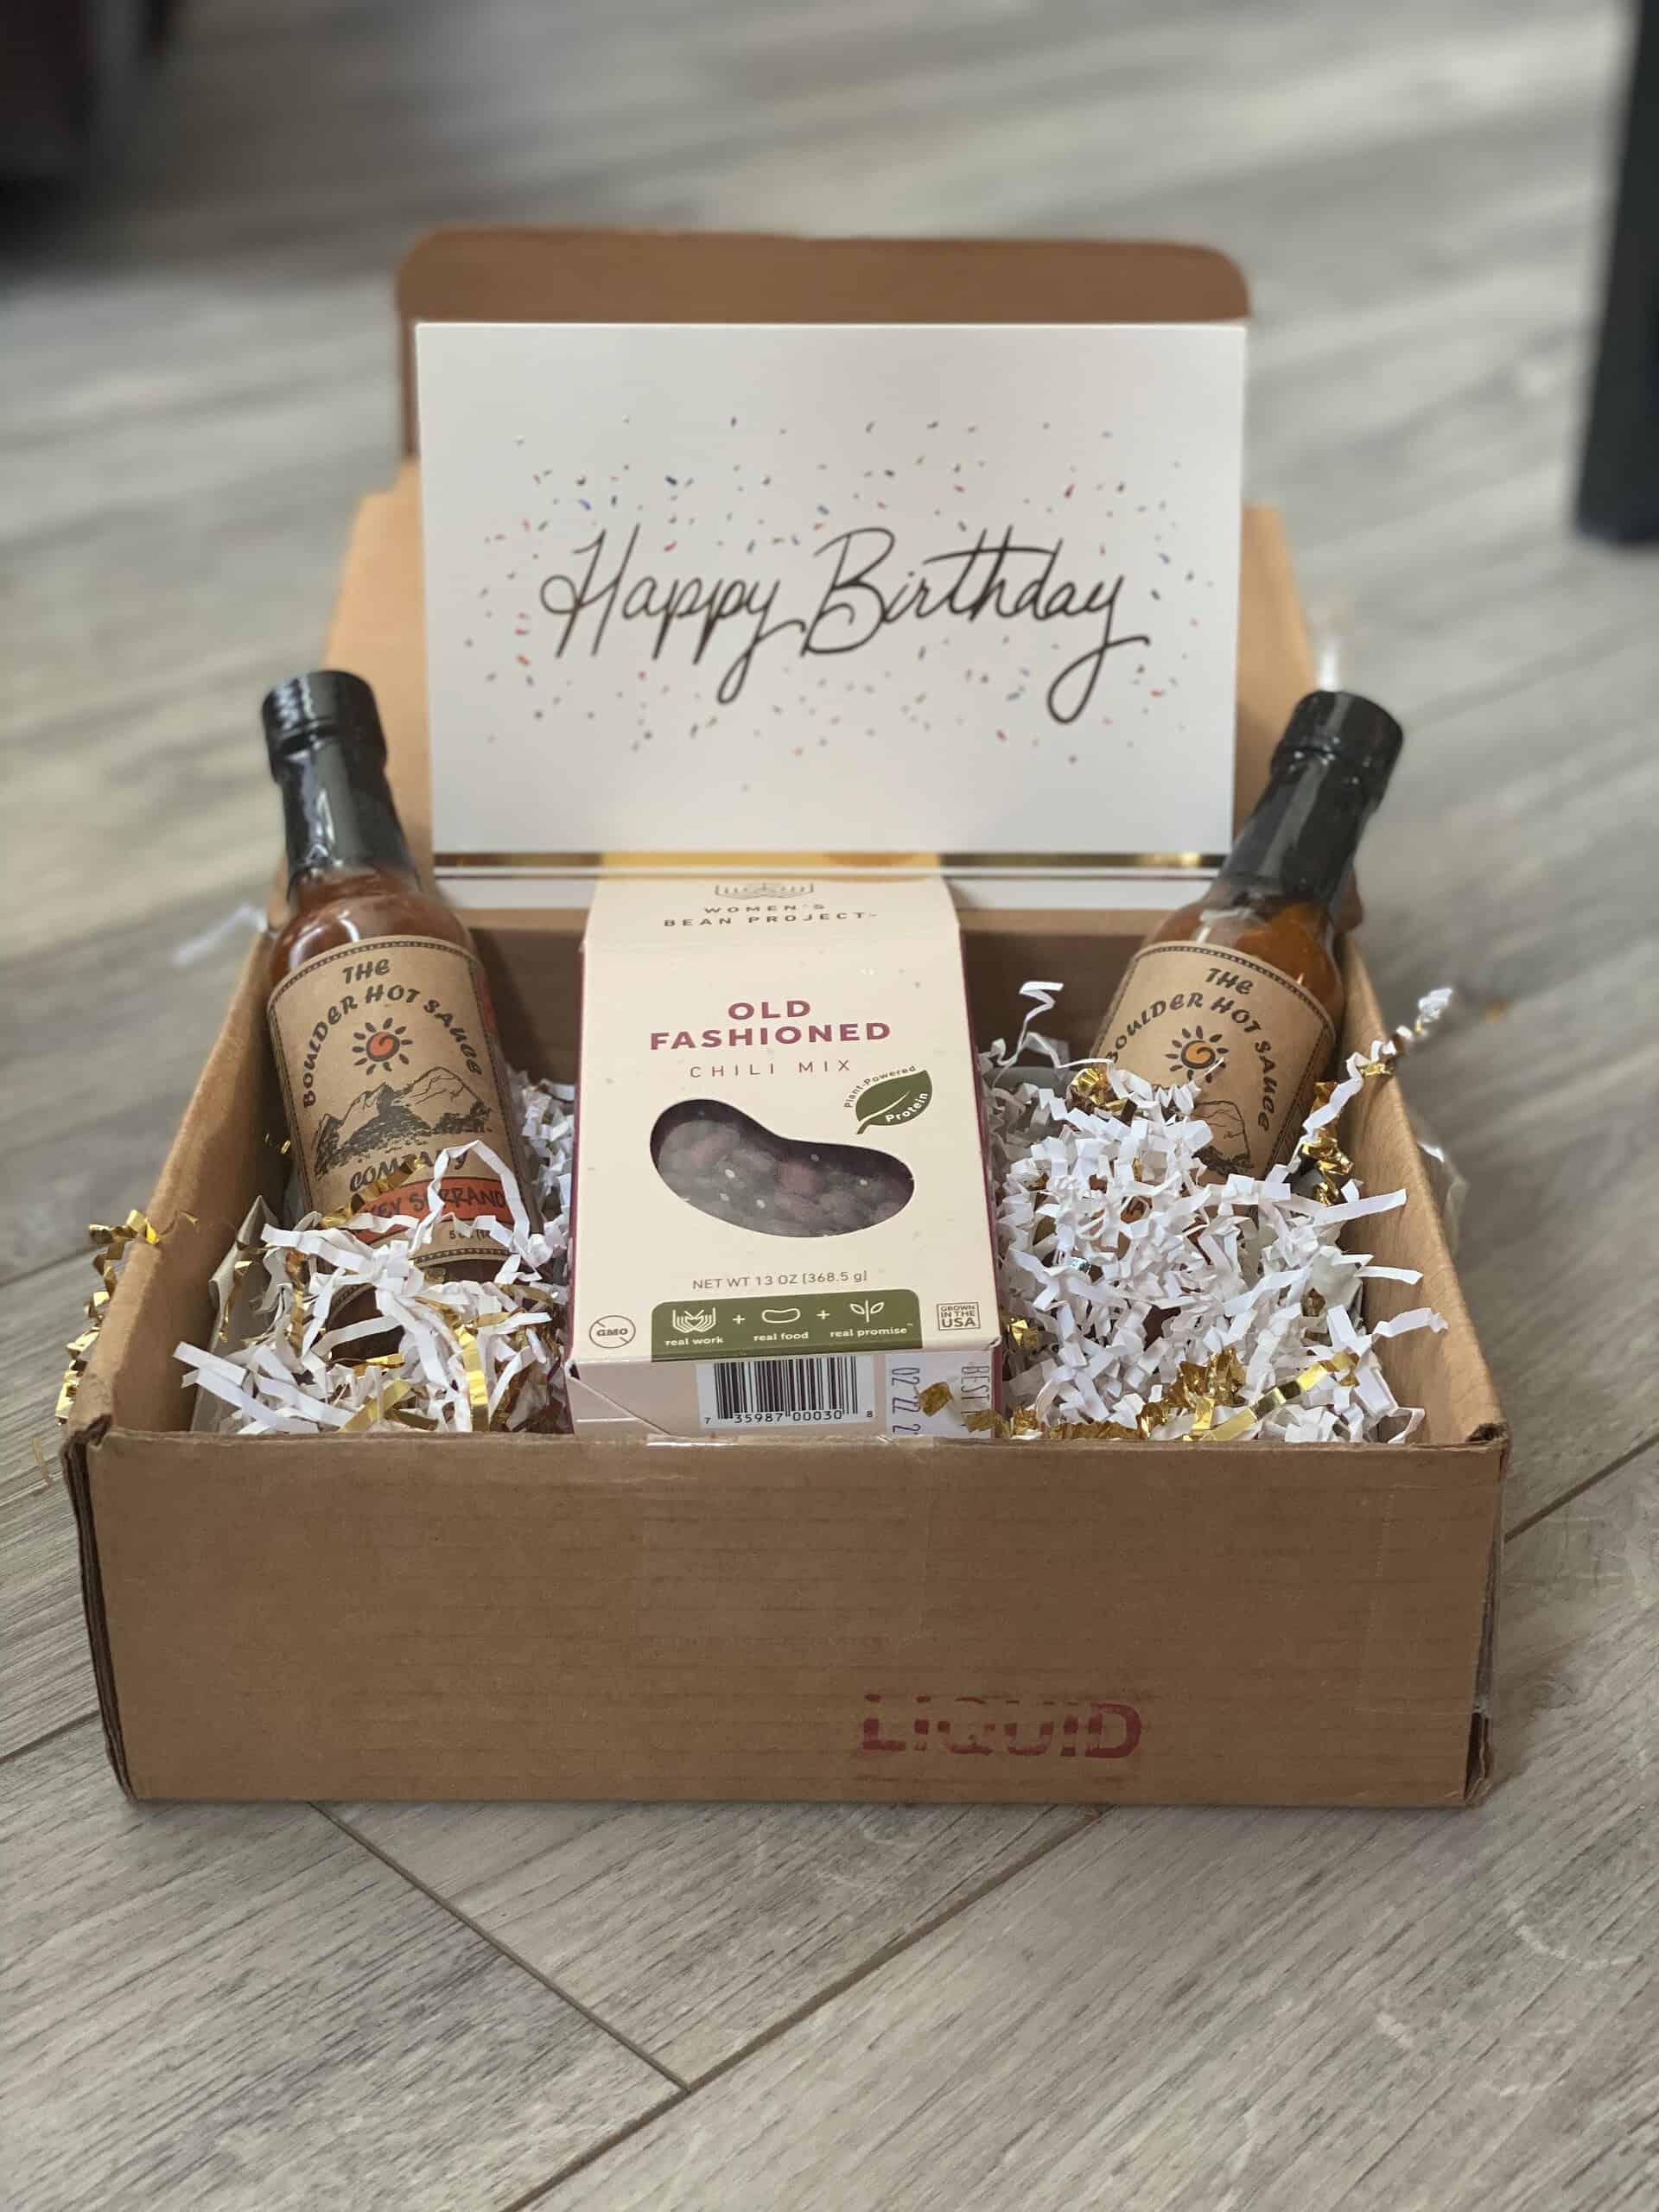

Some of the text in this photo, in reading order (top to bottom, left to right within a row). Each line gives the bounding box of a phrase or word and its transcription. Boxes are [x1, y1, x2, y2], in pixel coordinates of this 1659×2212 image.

[540, 522, 1150, 723] Happy Birthday
[664, 917, 732, 926] BEAN
[342, 959, 390, 984] THE
[1205, 968, 1253, 995] THE
[728, 1000, 811, 1020] OLD
[650, 1022, 891, 1050] FASHIONED
[302, 983, 482, 1109] BOULDER HOT SAUCE
[690, 1059, 851, 1078] CHILI MIX
[1211, 996, 1262, 1034] HOT
[1255, 1040, 1278, 1132] SAUCE
[844, 1065, 917, 1108] Plant-Powered
[885, 1092, 929, 1122] Protein
[692, 1278, 722, 1289] NET
[727, 1277, 750, 1287] WT
[756, 1275, 773, 1286] 13
[778, 1274, 798, 1285] OZ
[596, 1327, 628, 1337] GMO
[942, 1318, 976, 1328] USA
[664, 1336, 724, 1346] real work
[753, 1331, 809, 1342] real food
[830, 1328, 854, 1338] real
[734, 1412, 783, 1423] 35987
[792, 1410, 842, 1421] 00030
